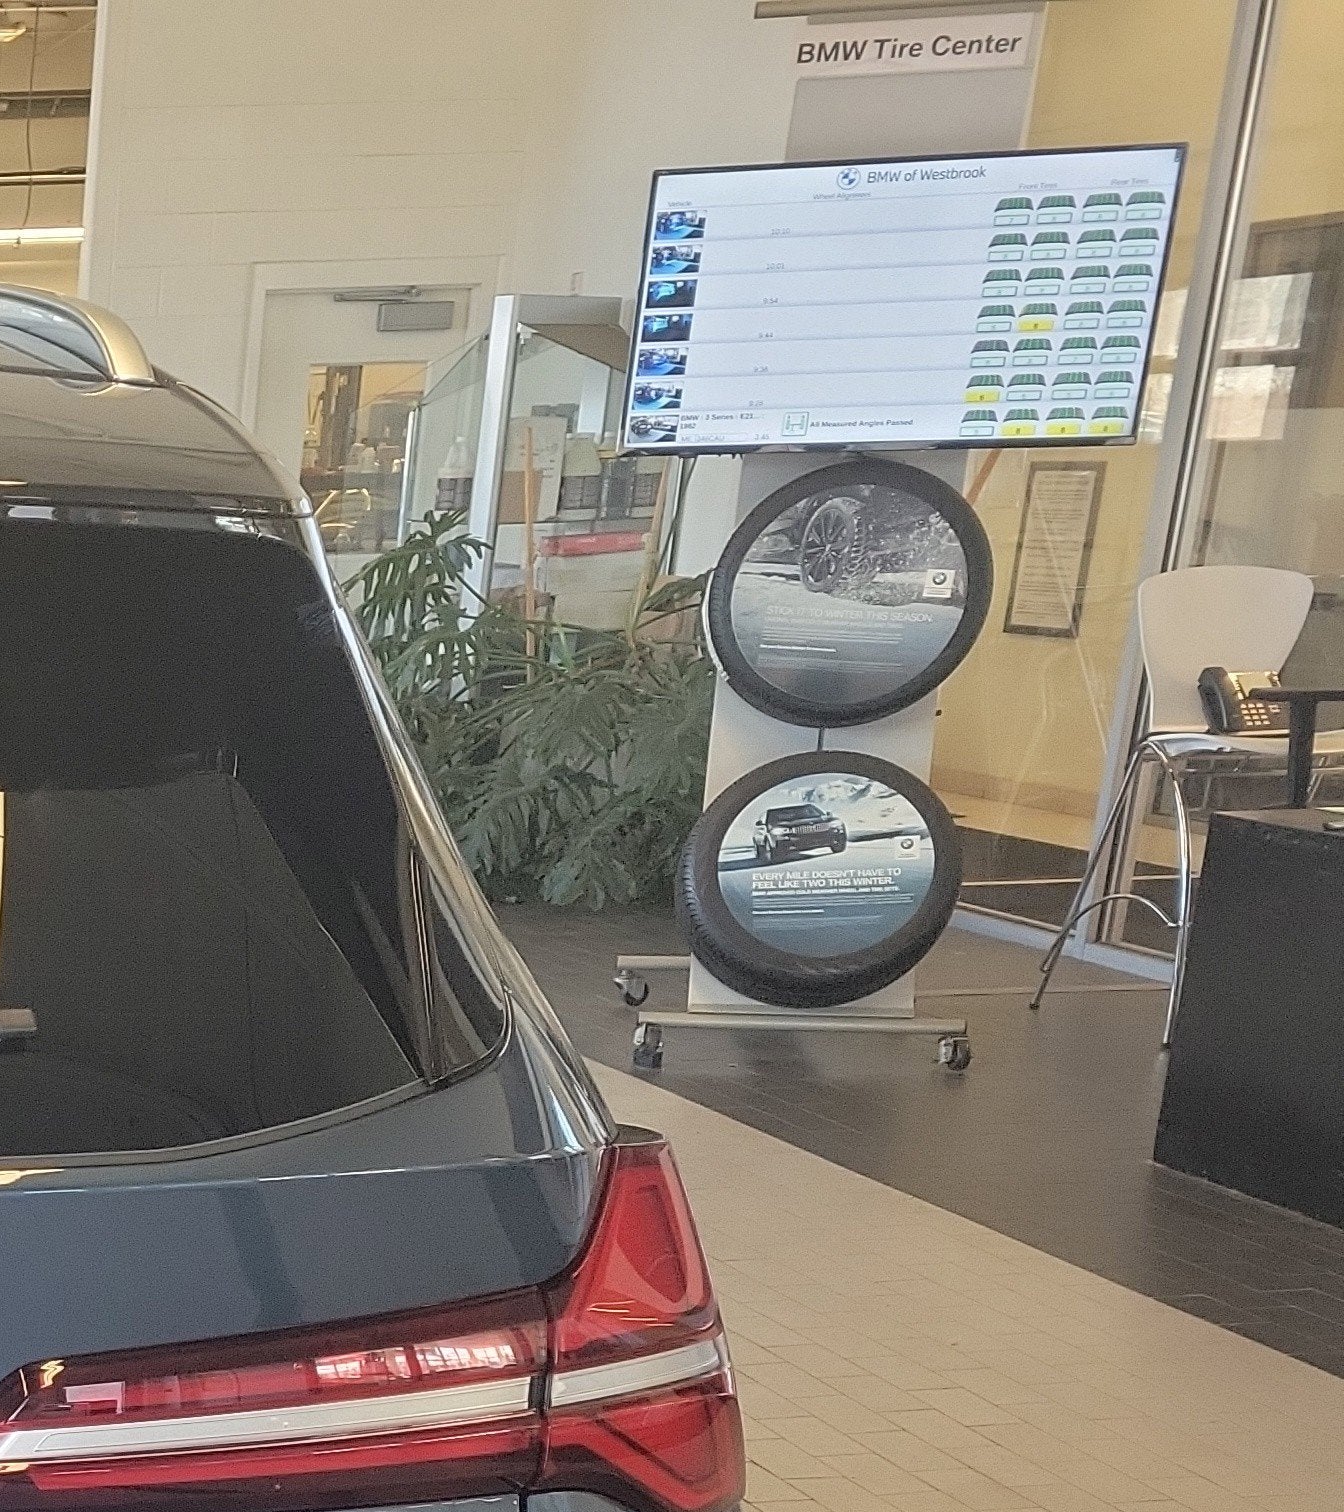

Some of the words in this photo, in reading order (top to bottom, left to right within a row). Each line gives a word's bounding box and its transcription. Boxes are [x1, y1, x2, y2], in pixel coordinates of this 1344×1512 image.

[797, 39, 868, 64] BMW
[873, 37, 924, 60] Tire
[931, 34, 1023, 57] Center
[867, 170, 902, 184] BMW
[904, 169, 919, 182] of
[920, 165, 988, 181] Westbrook
[752, 872, 784, 882] EVERY
[786, 870, 810, 880] MILE
[812, 869, 856, 879] DOESN'T
[857, 868, 885, 878] HAVE
[886, 867, 902, 877] TO
[752, 880, 778, 890] FEEL
[778, 879, 800, 889] LIKE
[803, 878, 826, 888] TWO
[828, 877, 851, 887] THIS
[852, 876, 895, 886] WINTER.
